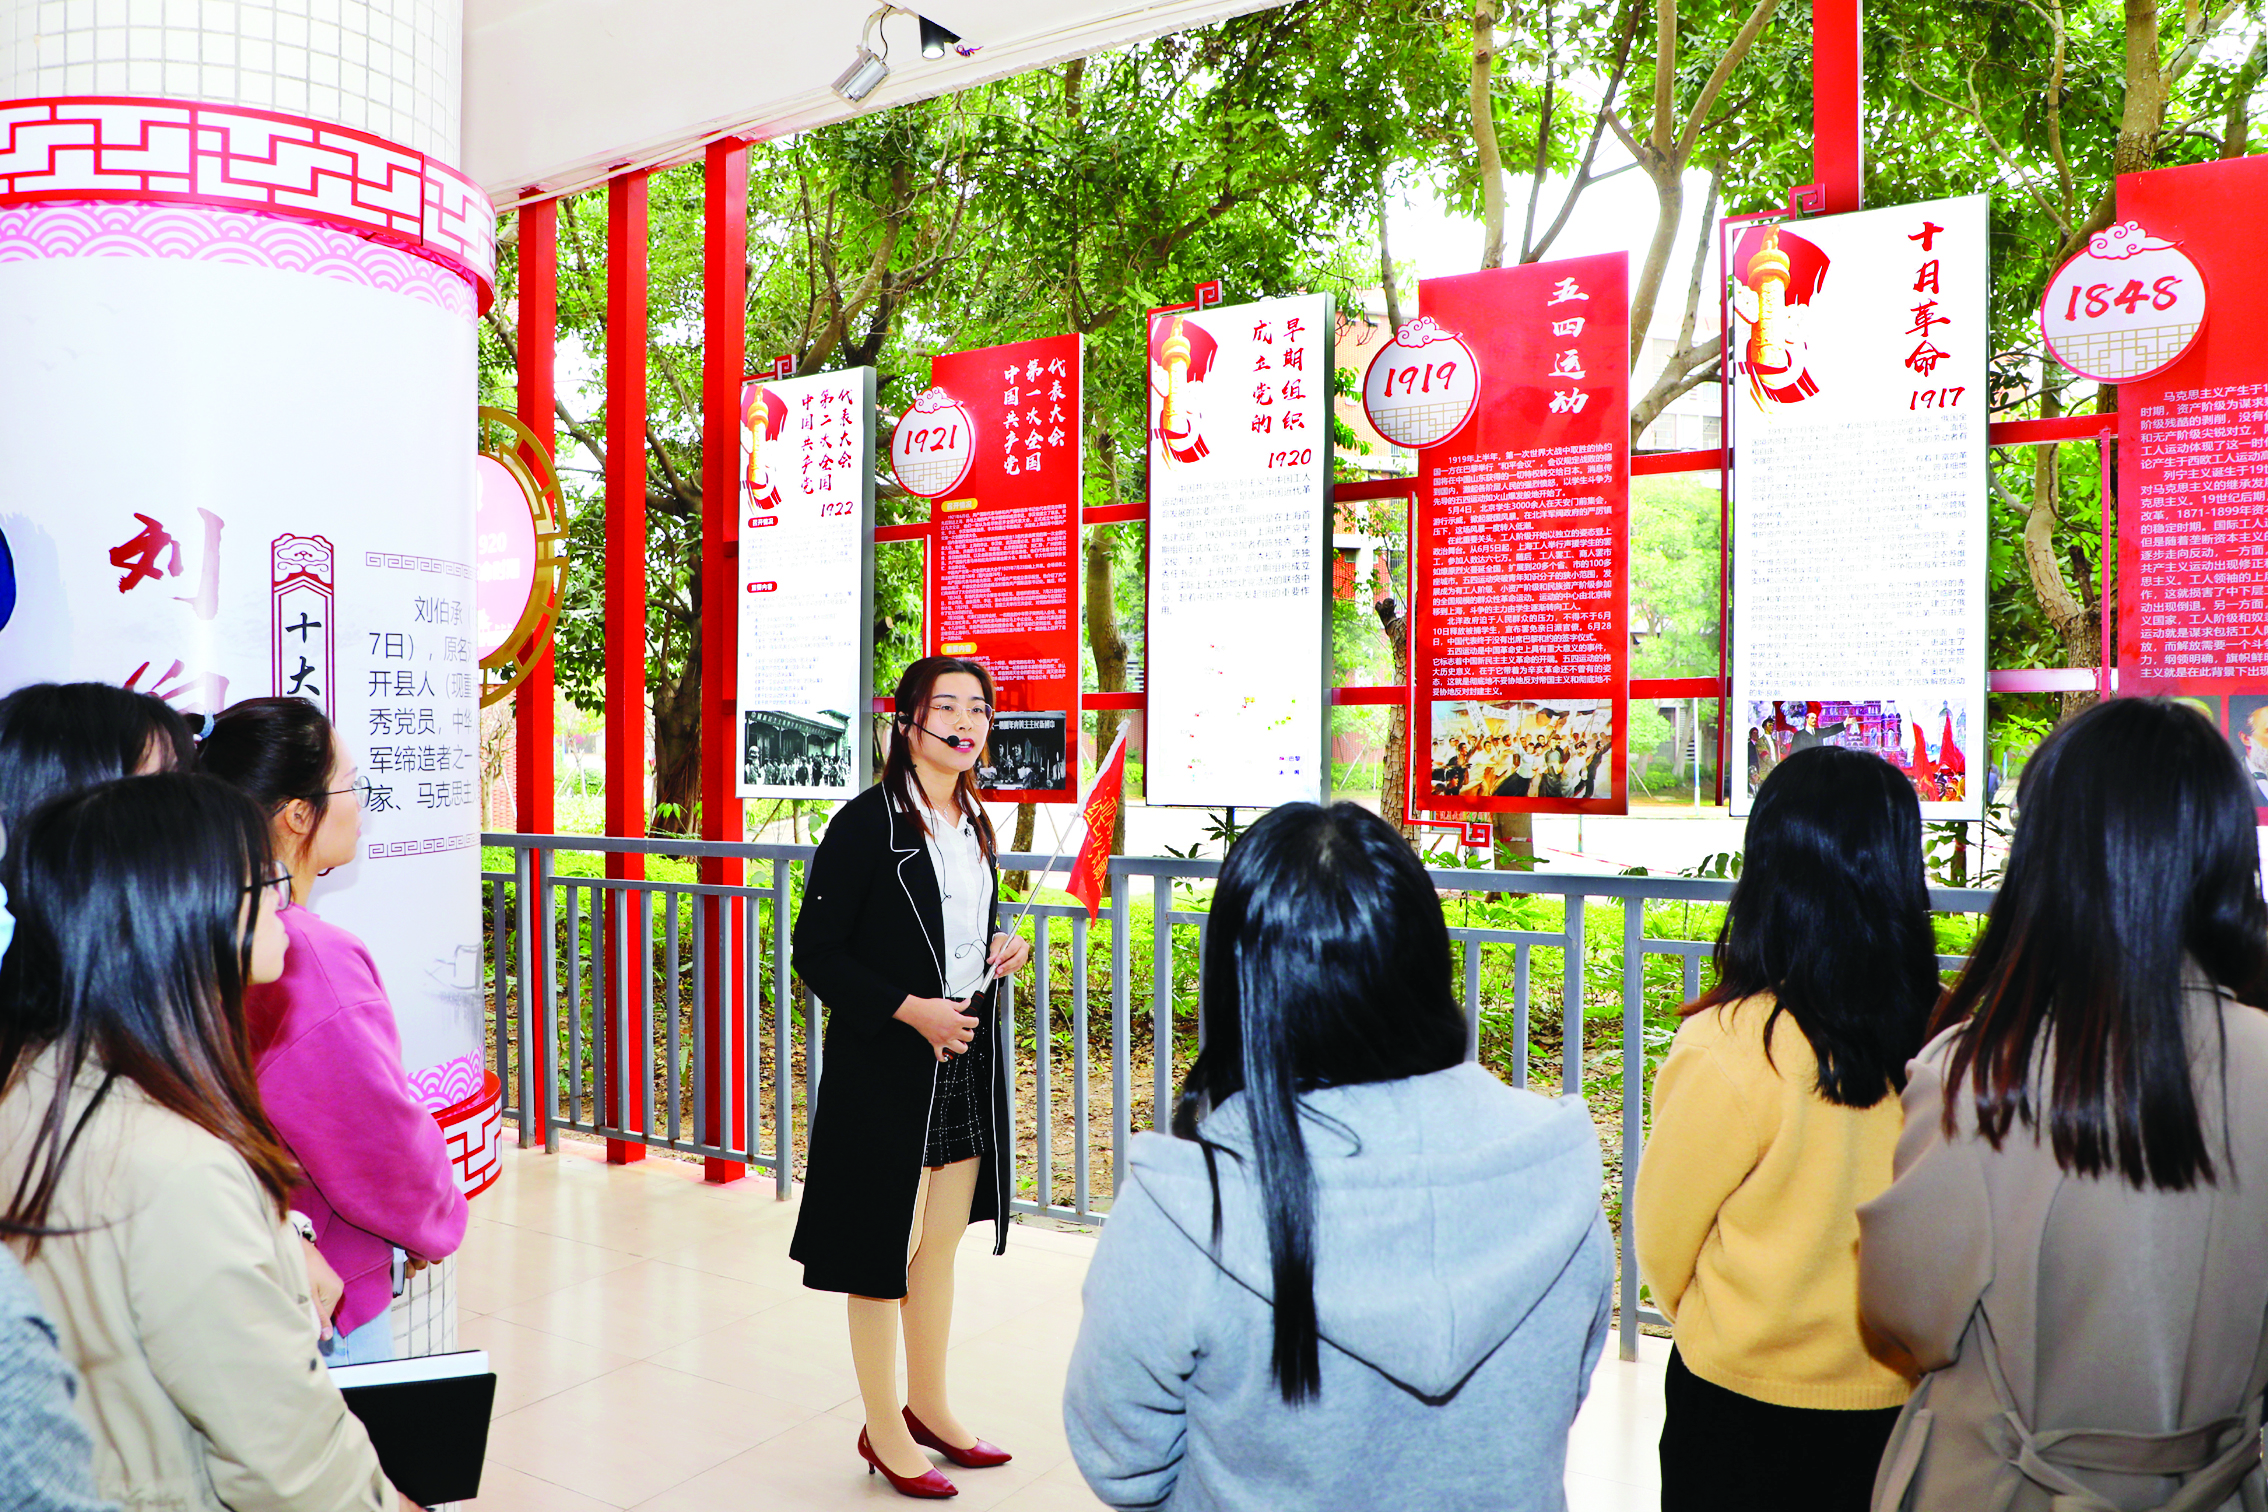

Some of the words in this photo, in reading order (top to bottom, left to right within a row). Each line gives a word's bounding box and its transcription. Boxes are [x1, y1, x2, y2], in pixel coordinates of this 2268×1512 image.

[1905, 221, 1951, 377] 十月革命
[2065, 276, 2183, 321] 1848
[1548, 277, 1590, 414] 五四运动
[1252, 319, 1273, 434] 成立党的
[1281, 317, 1306, 431] 早期组织
[1384, 362, 1457, 397] 1919
[1003, 364, 1020, 476] 中国共产党
[1024, 358, 1044, 472] 第一次全国
[1047, 357, 1067, 447] 代表大会
[1909, 386, 1965, 410] 1917
[801, 393, 814, 495] 中国共产党
[819, 388, 834, 491] 第二次全国
[838, 388, 853, 469] 代表大会
[904, 424, 957, 455] 1921
[1268, 448, 1312, 468] 1920
[821, 501, 853, 517] 1922
[478, 531, 508, 555] 920
[285, 612, 322, 696] 十大
[369, 632, 474, 663] 7日），原名
[369, 670, 475, 700] 开县人（现重
[369, 707, 475, 736] 秀党员，中华
[370, 743, 473, 774] 军缔造者之一
[370, 780, 477, 812] 家、马克思主
